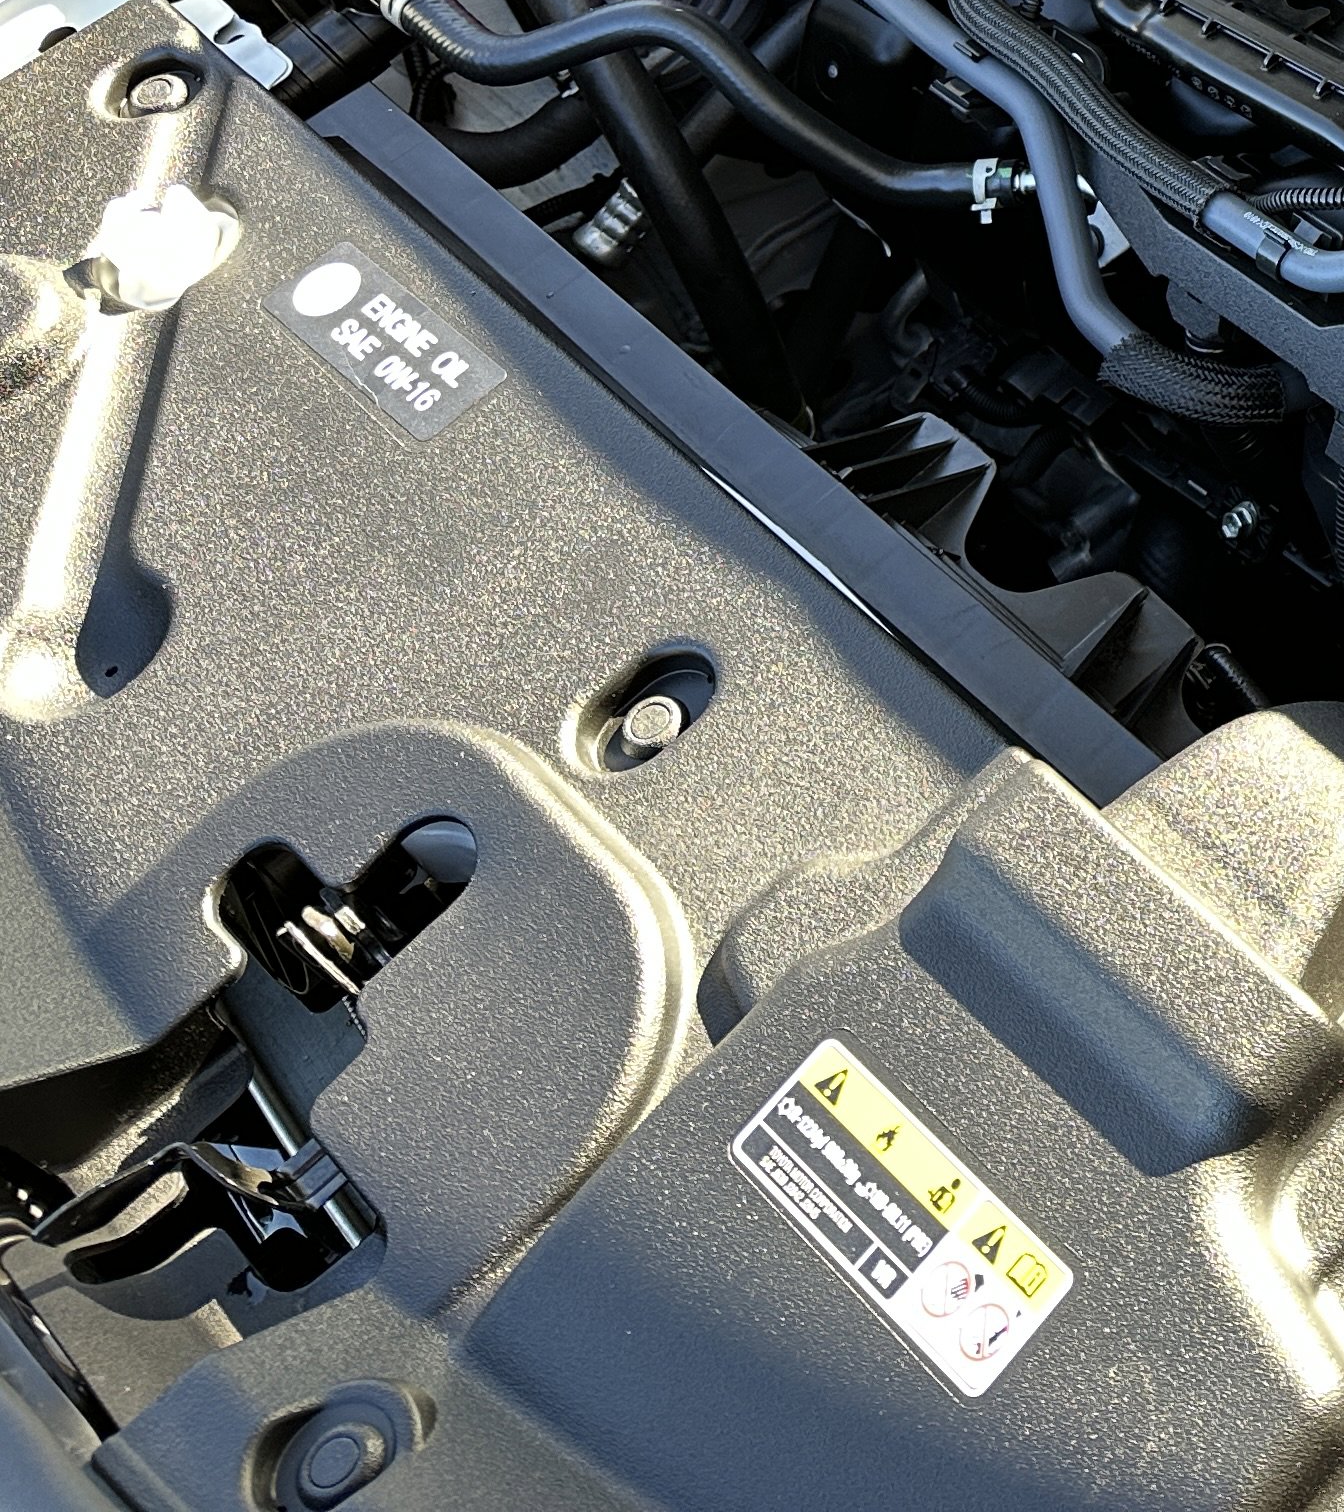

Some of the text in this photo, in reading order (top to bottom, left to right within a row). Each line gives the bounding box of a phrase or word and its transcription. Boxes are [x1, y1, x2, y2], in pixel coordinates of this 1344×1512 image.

[328, 317, 443, 415] SAE 0W-16
[359, 291, 470, 390] ENGINE OIL
[769, 1145, 853, 1234] TOYOTA MOTOR CORPORATION
